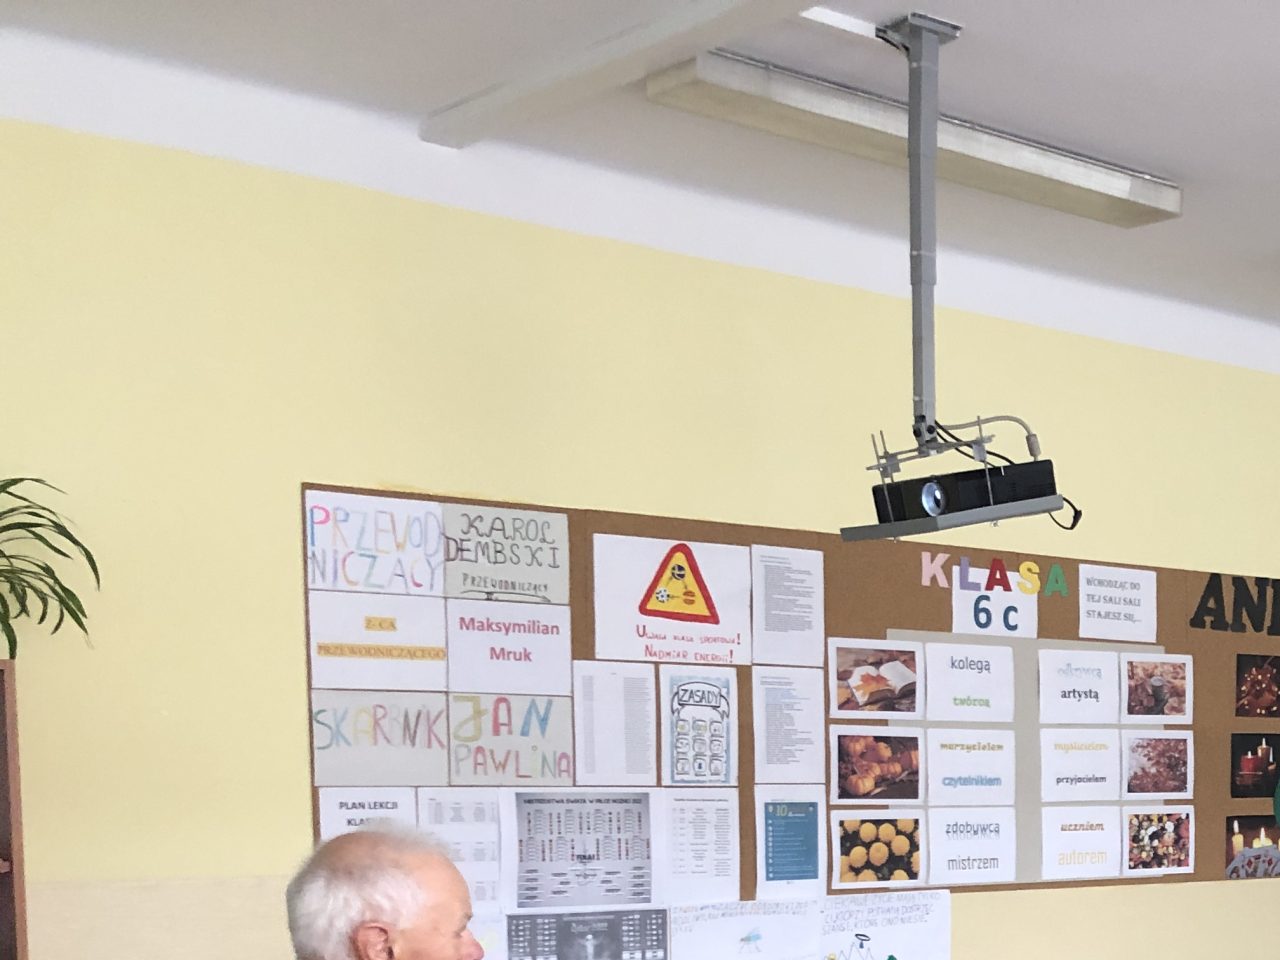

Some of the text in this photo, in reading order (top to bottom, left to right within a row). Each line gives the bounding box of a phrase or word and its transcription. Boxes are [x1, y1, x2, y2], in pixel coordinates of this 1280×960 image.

[921, 551, 1069, 597] KLASA
[1087, 594, 1101, 603] TEJ
[1103, 595, 1121, 605] SALI
[973, 594, 992, 629] 6
[459, 617, 560, 636] Maksymilian
[490, 647, 532, 662] Mruk
[951, 656, 991, 674] kolegą
[1061, 689, 1100, 702] artystą
[339, 801, 398, 810] PLAN LEKCJI
[1061, 821, 1104, 831] uczniem
[948, 855, 999, 871] mistrzem
